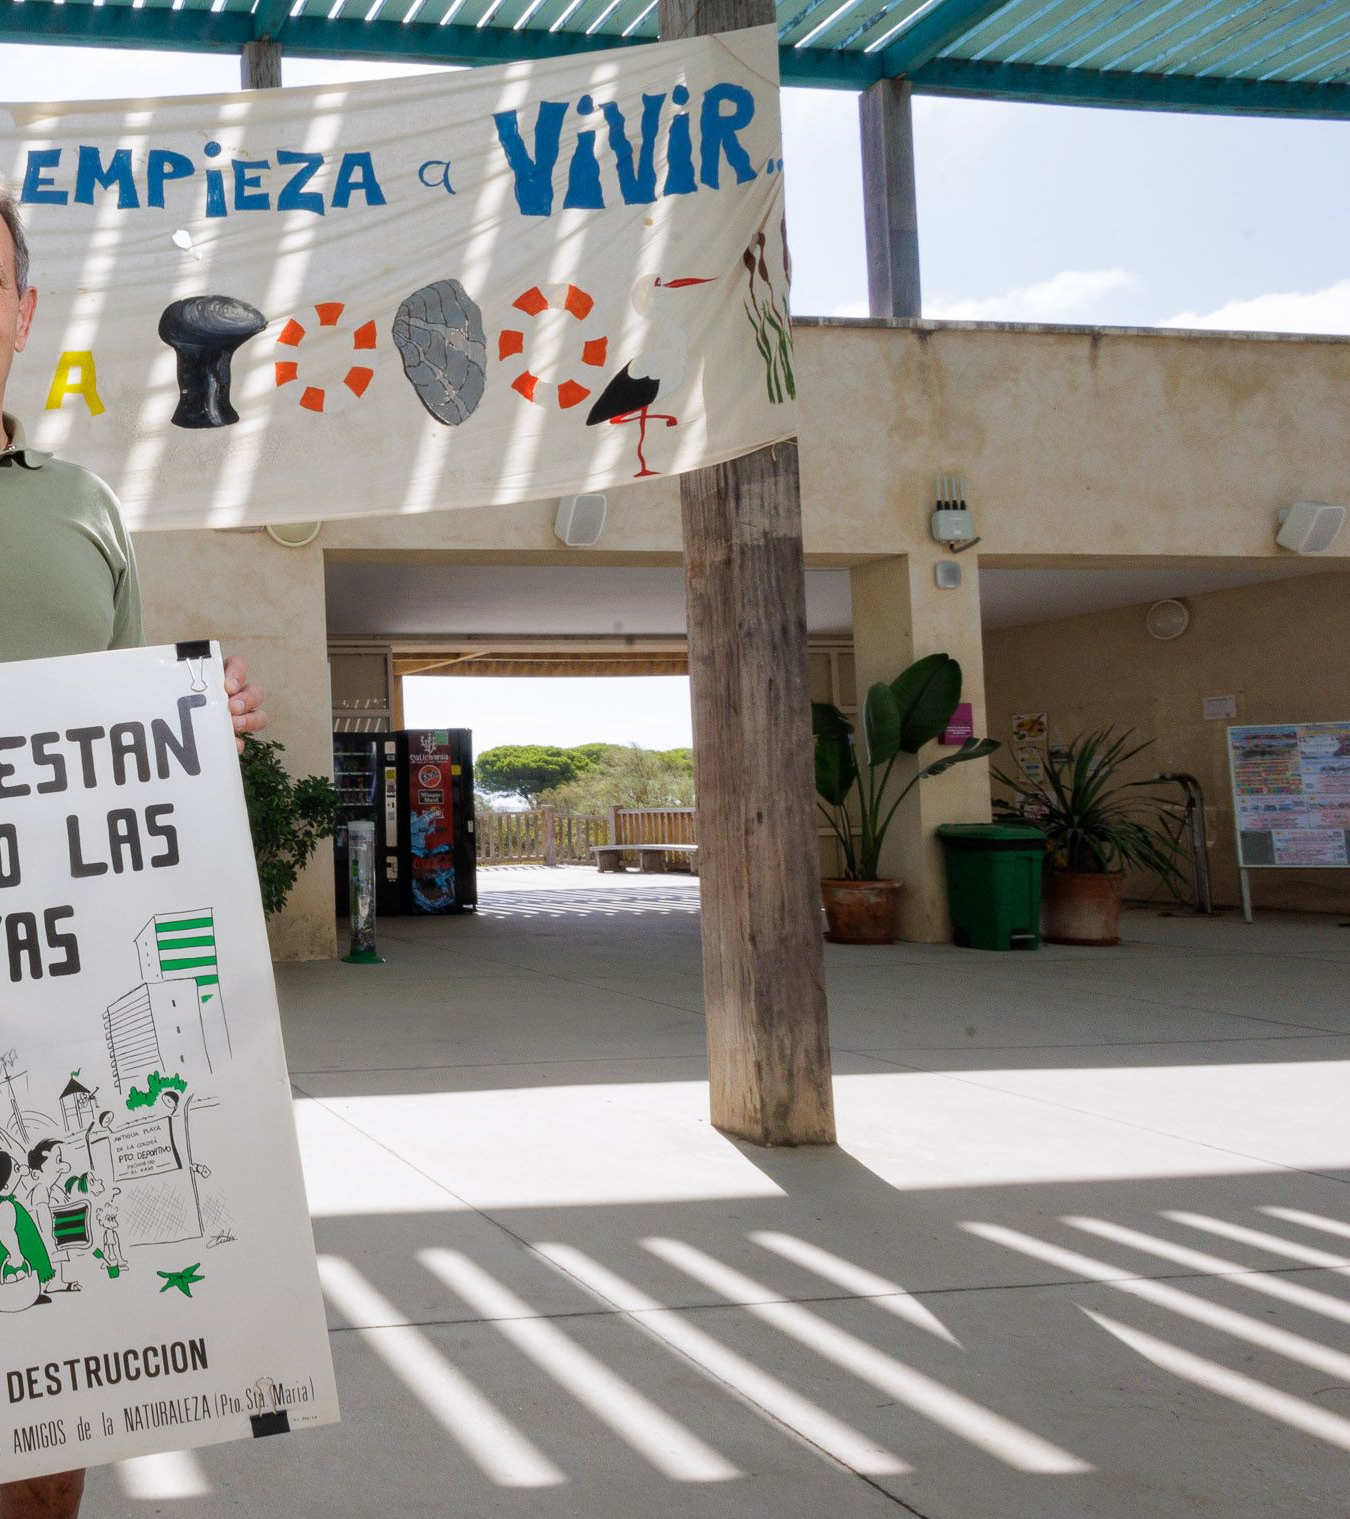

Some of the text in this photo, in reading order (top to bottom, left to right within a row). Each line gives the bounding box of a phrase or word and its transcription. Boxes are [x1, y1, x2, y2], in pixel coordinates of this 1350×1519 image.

[418, 159, 457, 196] a
[44, 351, 106, 417] A
[66, 803, 180, 878] LAS
[114, 1125, 162, 1143] ANTIGUA PLAYA
[137, 1145, 172, 1160] DEPORTIVO
[6, 1338, 209, 1404] DESTRUCCION
[13, 1419, 67, 1455] AMIGOS
[77, 1415, 92, 1442] de
[101, 1411, 114, 1437] la
[123, 1394, 212, 1433] NATURALEZA
